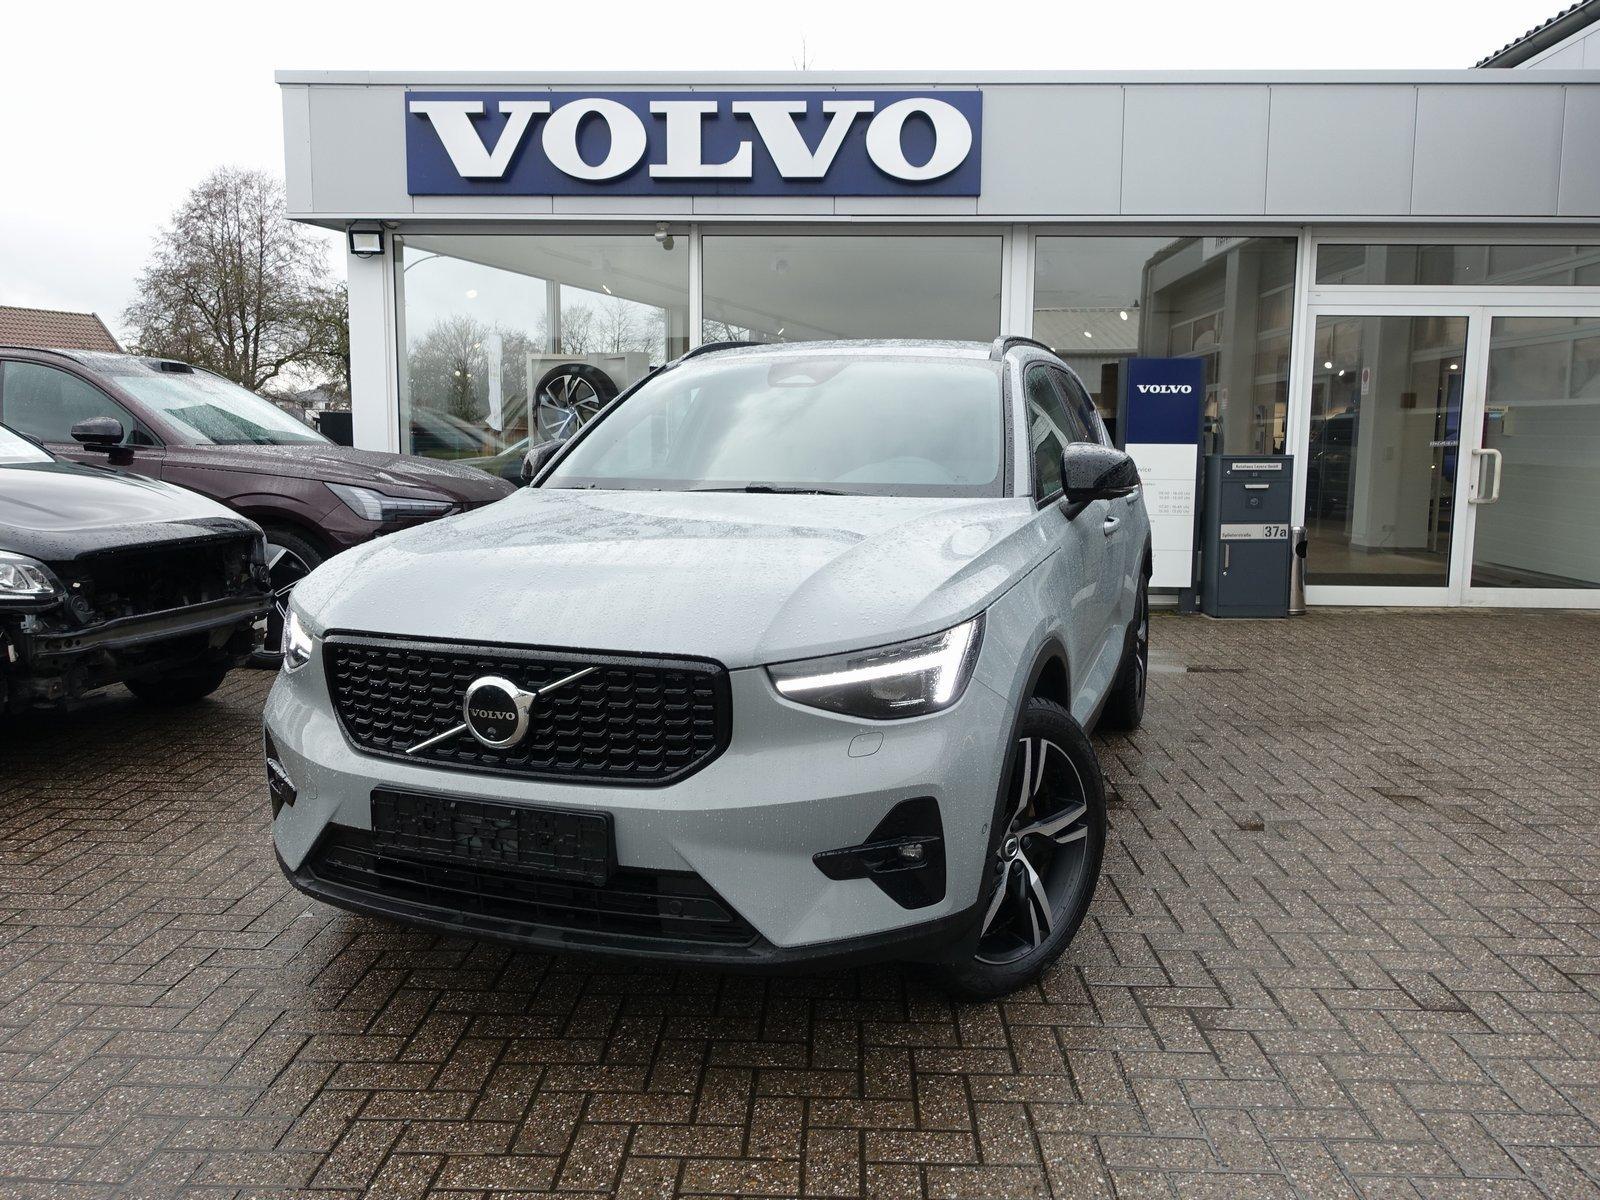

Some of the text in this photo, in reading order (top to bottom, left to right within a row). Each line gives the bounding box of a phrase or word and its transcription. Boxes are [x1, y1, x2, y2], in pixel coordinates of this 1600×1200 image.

[409, 97, 973, 181] VOLVO
[1137, 384, 1192, 394] VOLVO
[1264, 525, 1287, 538] 37a
[469, 708, 516, 721] VOLVO
